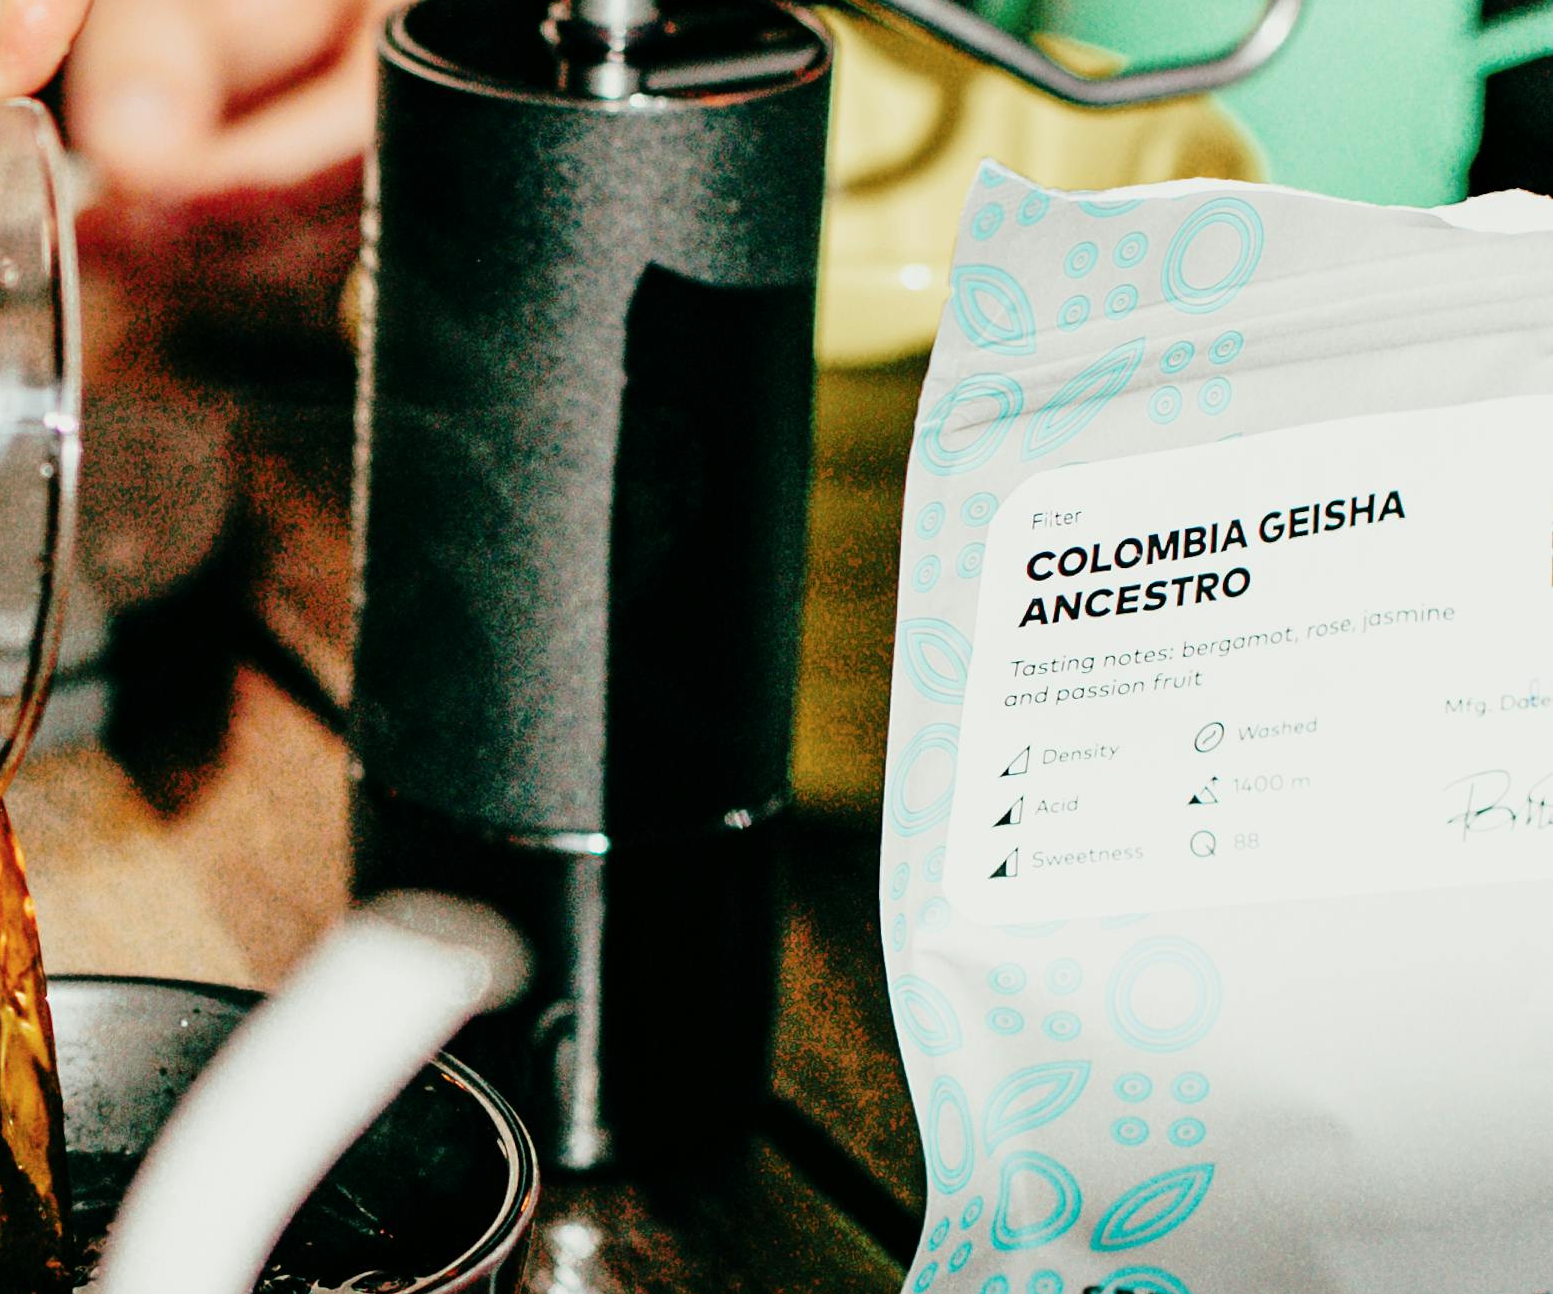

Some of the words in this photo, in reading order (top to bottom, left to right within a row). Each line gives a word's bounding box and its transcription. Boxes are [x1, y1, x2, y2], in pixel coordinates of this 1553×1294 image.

[1031, 508, 1083, 530] Filter
[1026, 518, 1248, 582] COLOMBIA
[1258, 490, 1406, 545] GEISHA
[1018, 566, 1251, 628] ANCESTRO
[1011, 652, 1095, 679] Tasting
[1103, 643, 1176, 668] notes:
[1182, 625, 1300, 660] bergamot,
[1306, 616, 1357, 641] rose,
[1360, 602, 1456, 635] jasmine
[1004, 685, 1049, 708] and
[1055, 677, 1145, 706] passion
[1152, 669, 1204, 691] fruit
[1238, 714, 1319, 742] Washed
[1042, 742, 1120, 767] Density
[1232, 773, 1285, 794] 1400
[1034, 793, 1079, 817] Acid
[1031, 845, 1145, 870] Sweetness
